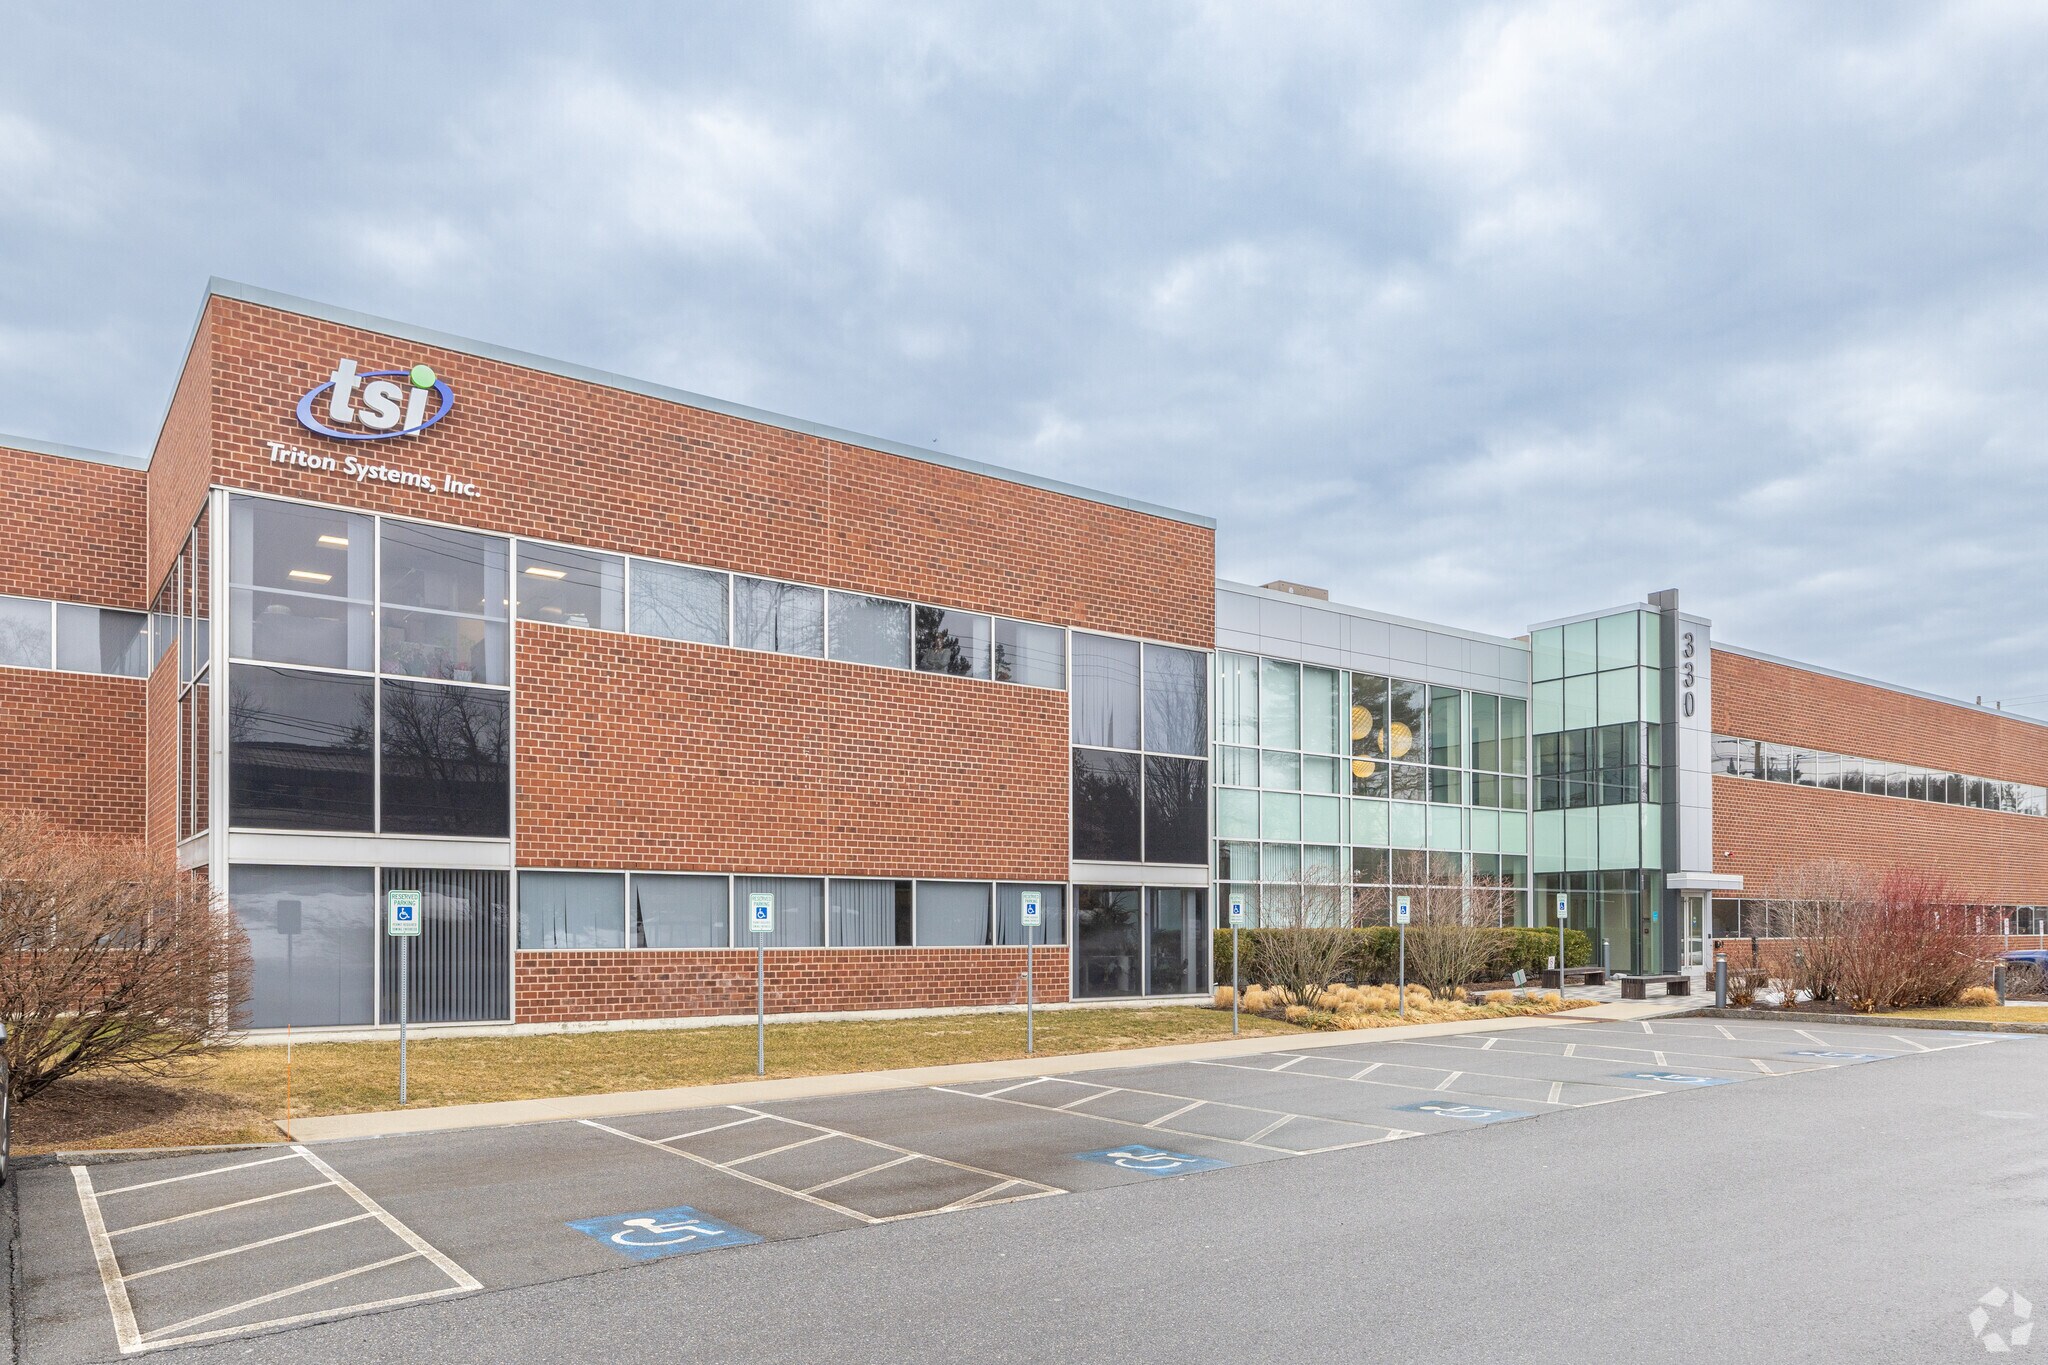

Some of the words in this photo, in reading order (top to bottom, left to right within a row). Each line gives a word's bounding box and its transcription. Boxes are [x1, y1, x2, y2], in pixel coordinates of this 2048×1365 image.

[329, 358, 436, 436] tsi
[267, 441, 336, 471] Triton
[343, 456, 436, 493] Systems,
[443, 474, 481, 497] Inc.
[1683, 632, 1695, 717] 330
